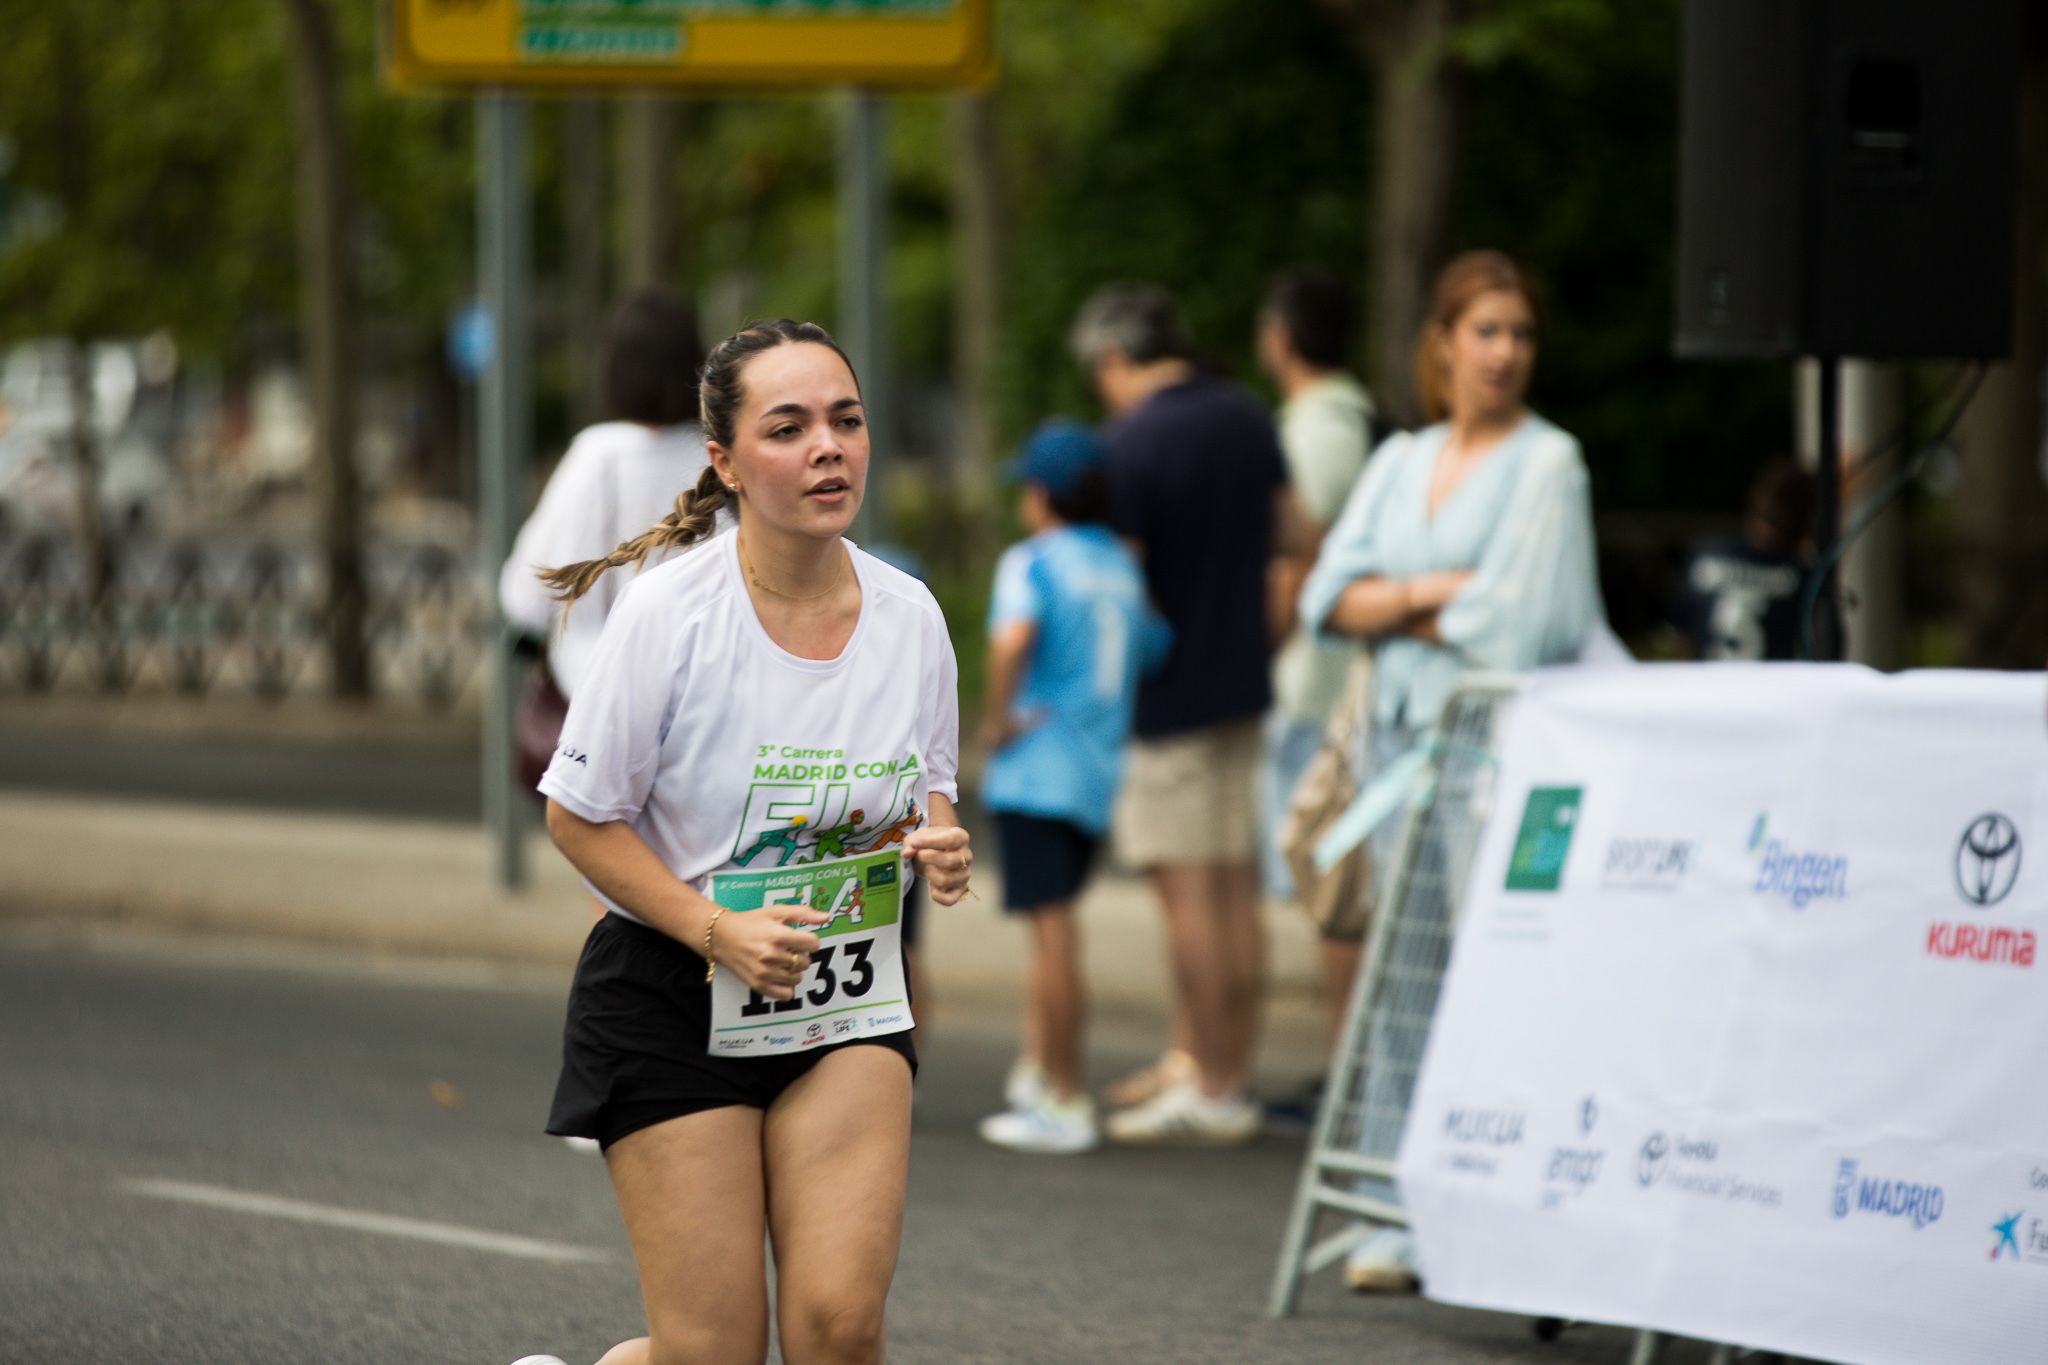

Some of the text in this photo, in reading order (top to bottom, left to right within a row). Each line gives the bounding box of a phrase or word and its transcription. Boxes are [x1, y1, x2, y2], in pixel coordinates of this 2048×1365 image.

[780, 745, 844, 759] Carrera
[753, 764, 847, 780] MADRID
[853, 759, 899, 779] CON
[765, 873, 814, 888] MADRID
[815, 868, 841, 881] CON
[842, 865, 858, 877] LA
[1755, 838, 1847, 909] Biogen
[1858, 1174, 1946, 1229] MADRID
